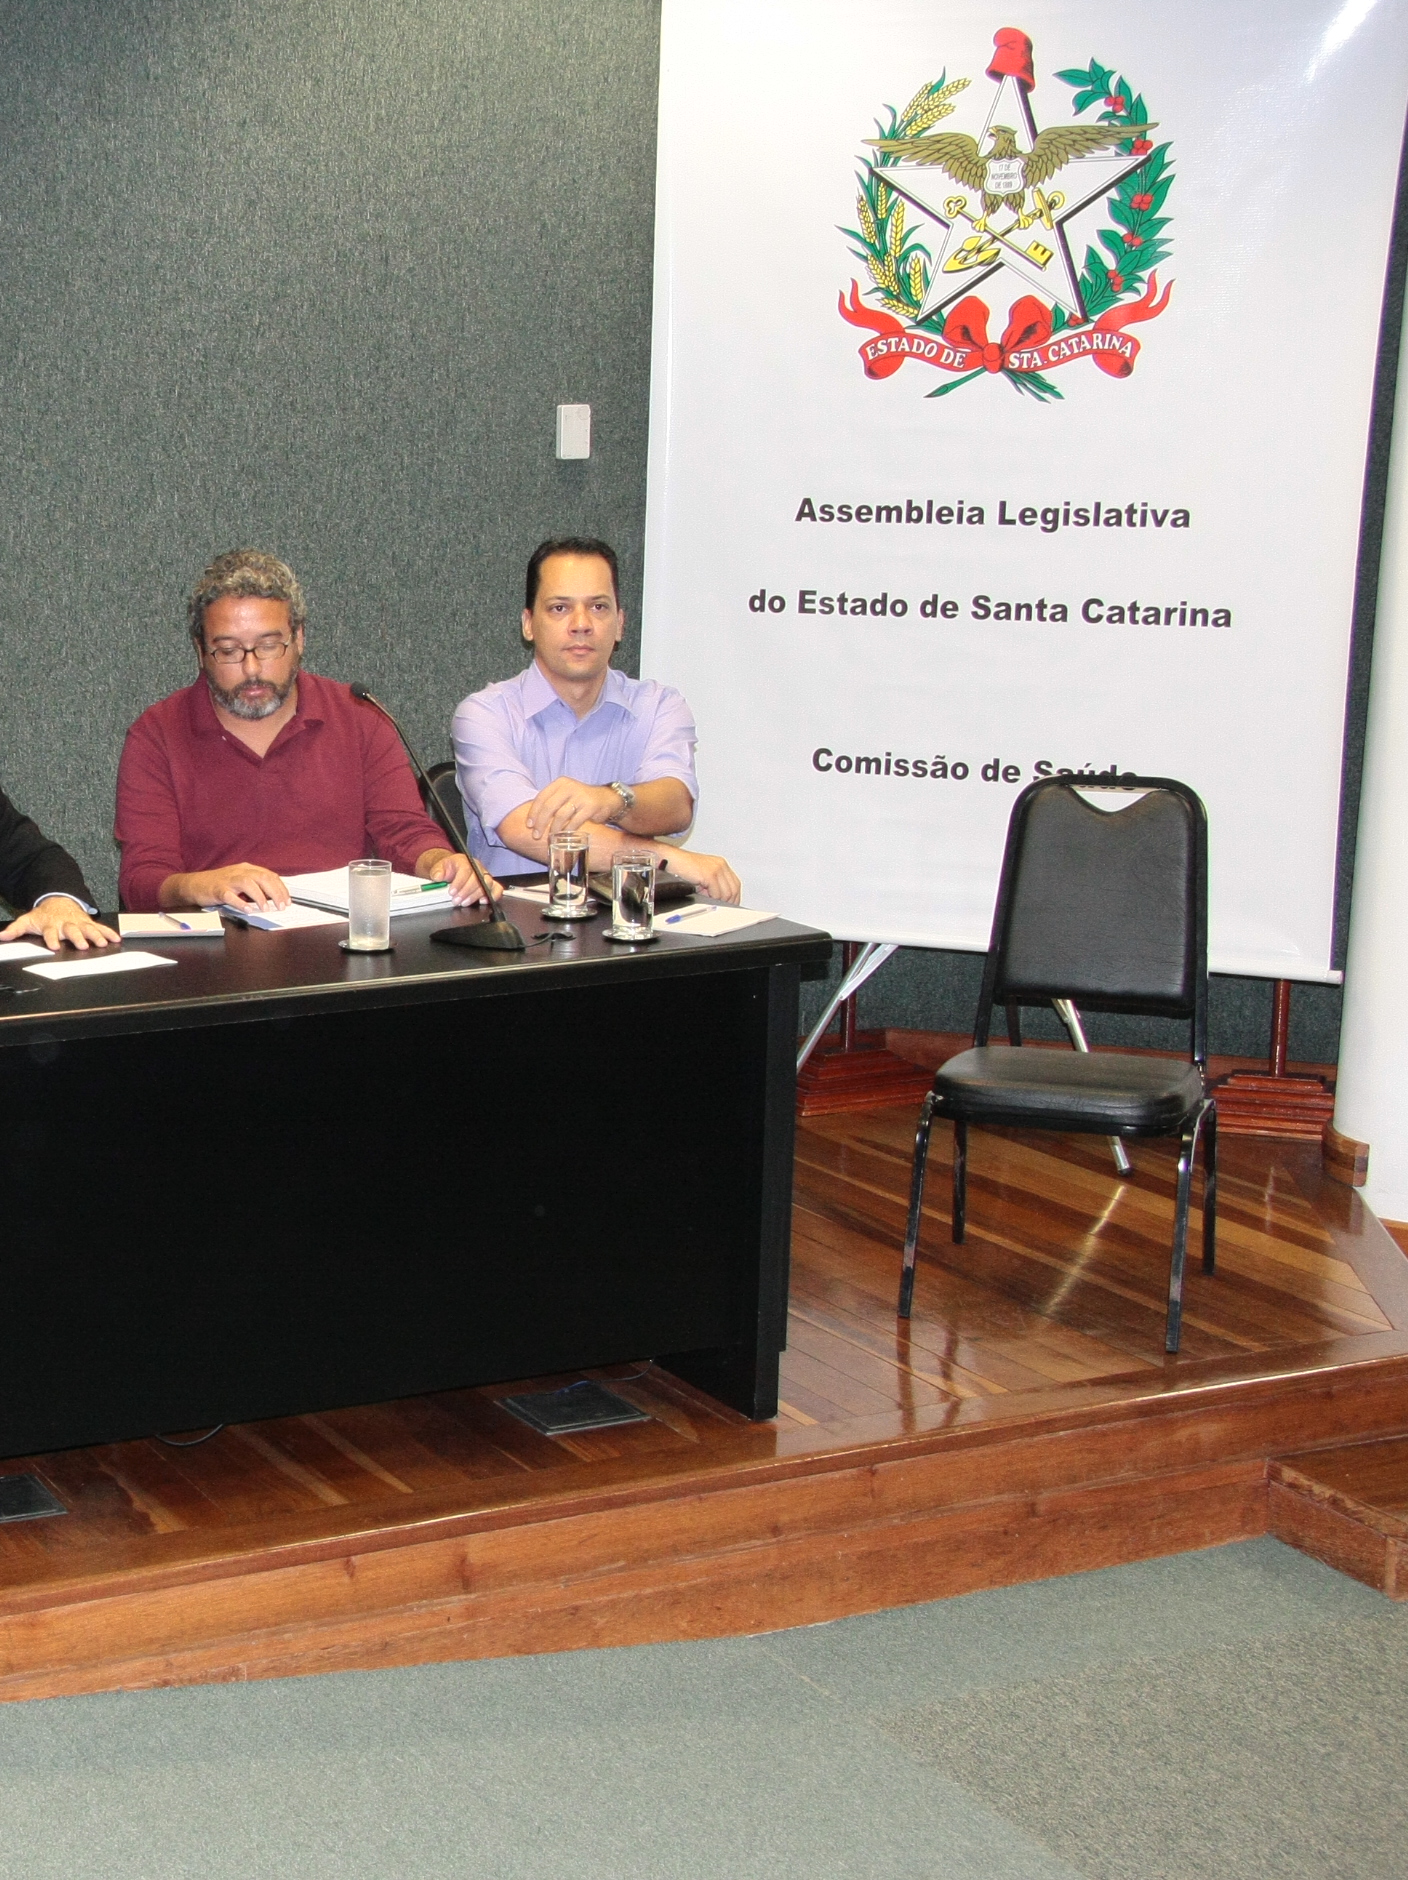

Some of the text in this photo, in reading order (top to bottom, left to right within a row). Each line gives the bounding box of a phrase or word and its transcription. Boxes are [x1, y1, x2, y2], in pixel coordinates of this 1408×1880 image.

[866, 337, 938, 360] ESTADO
[940, 348, 966, 369] DE
[1048, 333, 1133, 361] CATARINA
[795, 497, 1190, 533] Assembleia Legislativa
[748, 588, 1232, 628] do Estado de Santa Catarina
[812, 747, 970, 781] Comissão
[981, 757, 1021, 784] de
